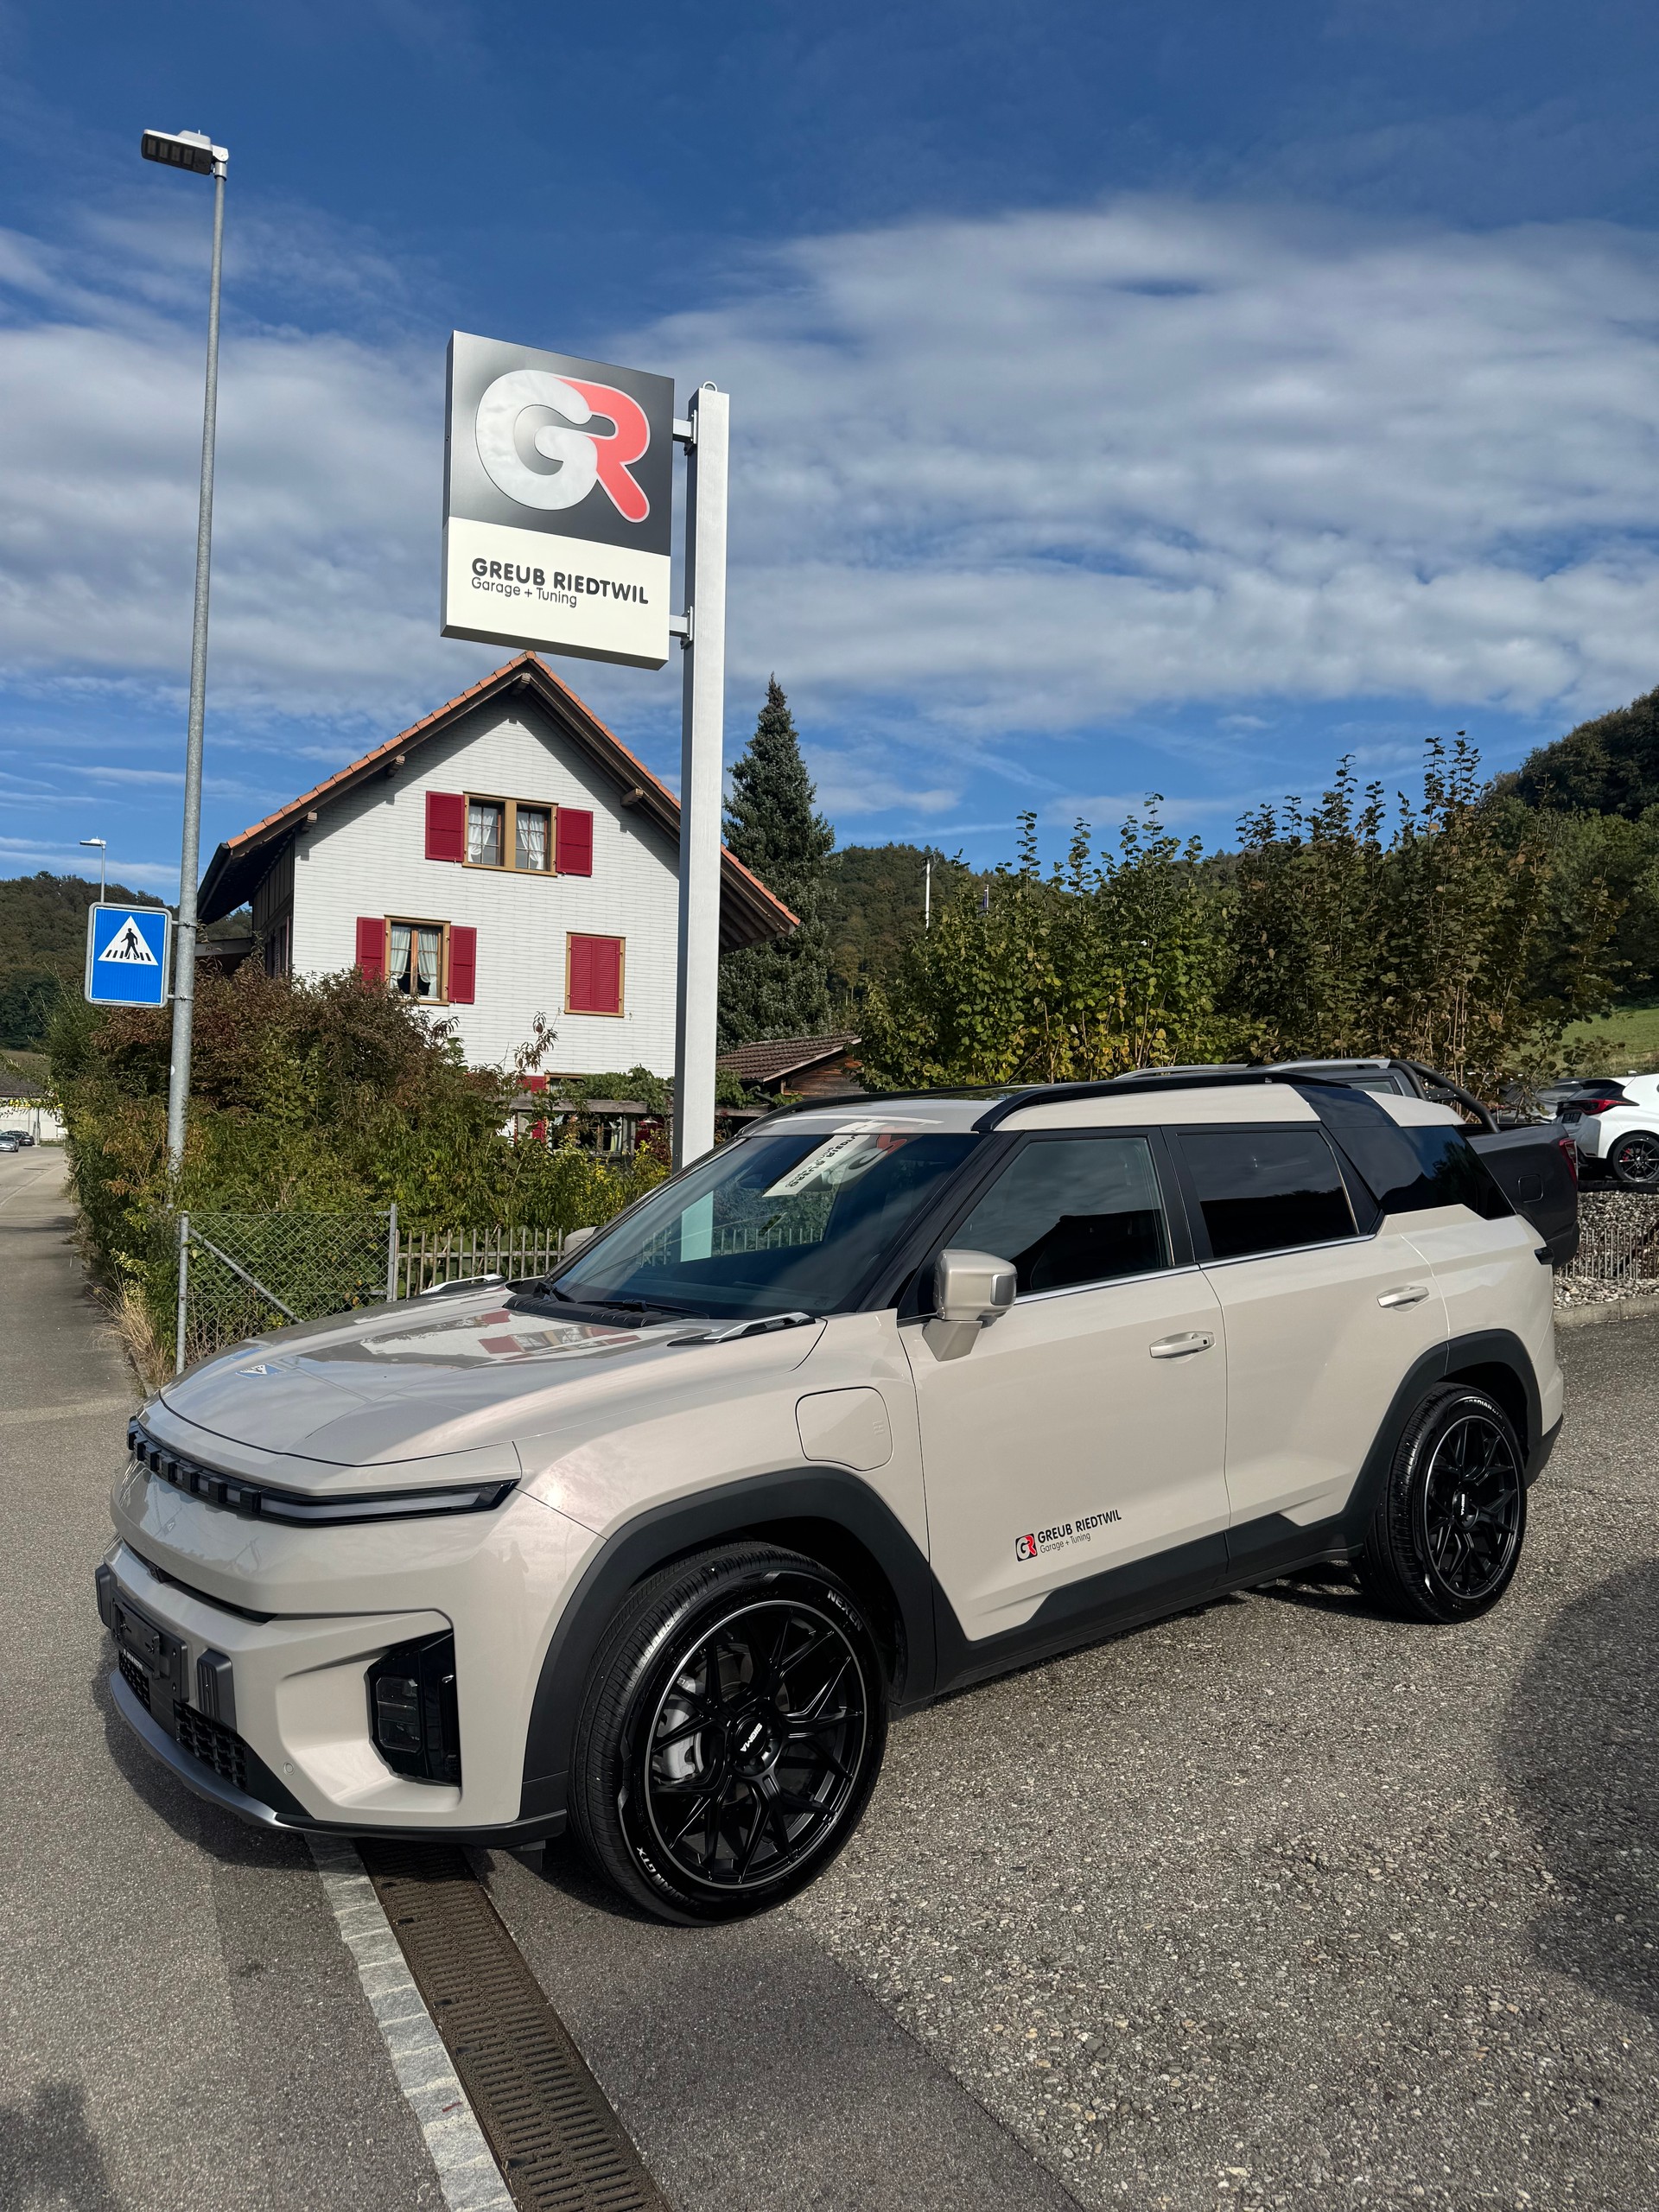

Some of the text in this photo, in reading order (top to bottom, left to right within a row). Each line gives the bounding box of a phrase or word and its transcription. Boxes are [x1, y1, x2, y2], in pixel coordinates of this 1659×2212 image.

[475, 370, 651, 523] GR
[471, 576, 577, 608] Garage + Tuning
[472, 557, 648, 605] GREUB RIEDTWIL
[1038, 1510, 1122, 1543] GREUB RIEDTWIL
[1016, 1535, 1037, 1560] GR
[1039, 1541, 1065, 1554] Garage
[1071, 1532, 1091, 1543] Tuning
[827, 1589, 863, 1631] NEXEN
[636, 1847, 657, 1873] GTX
